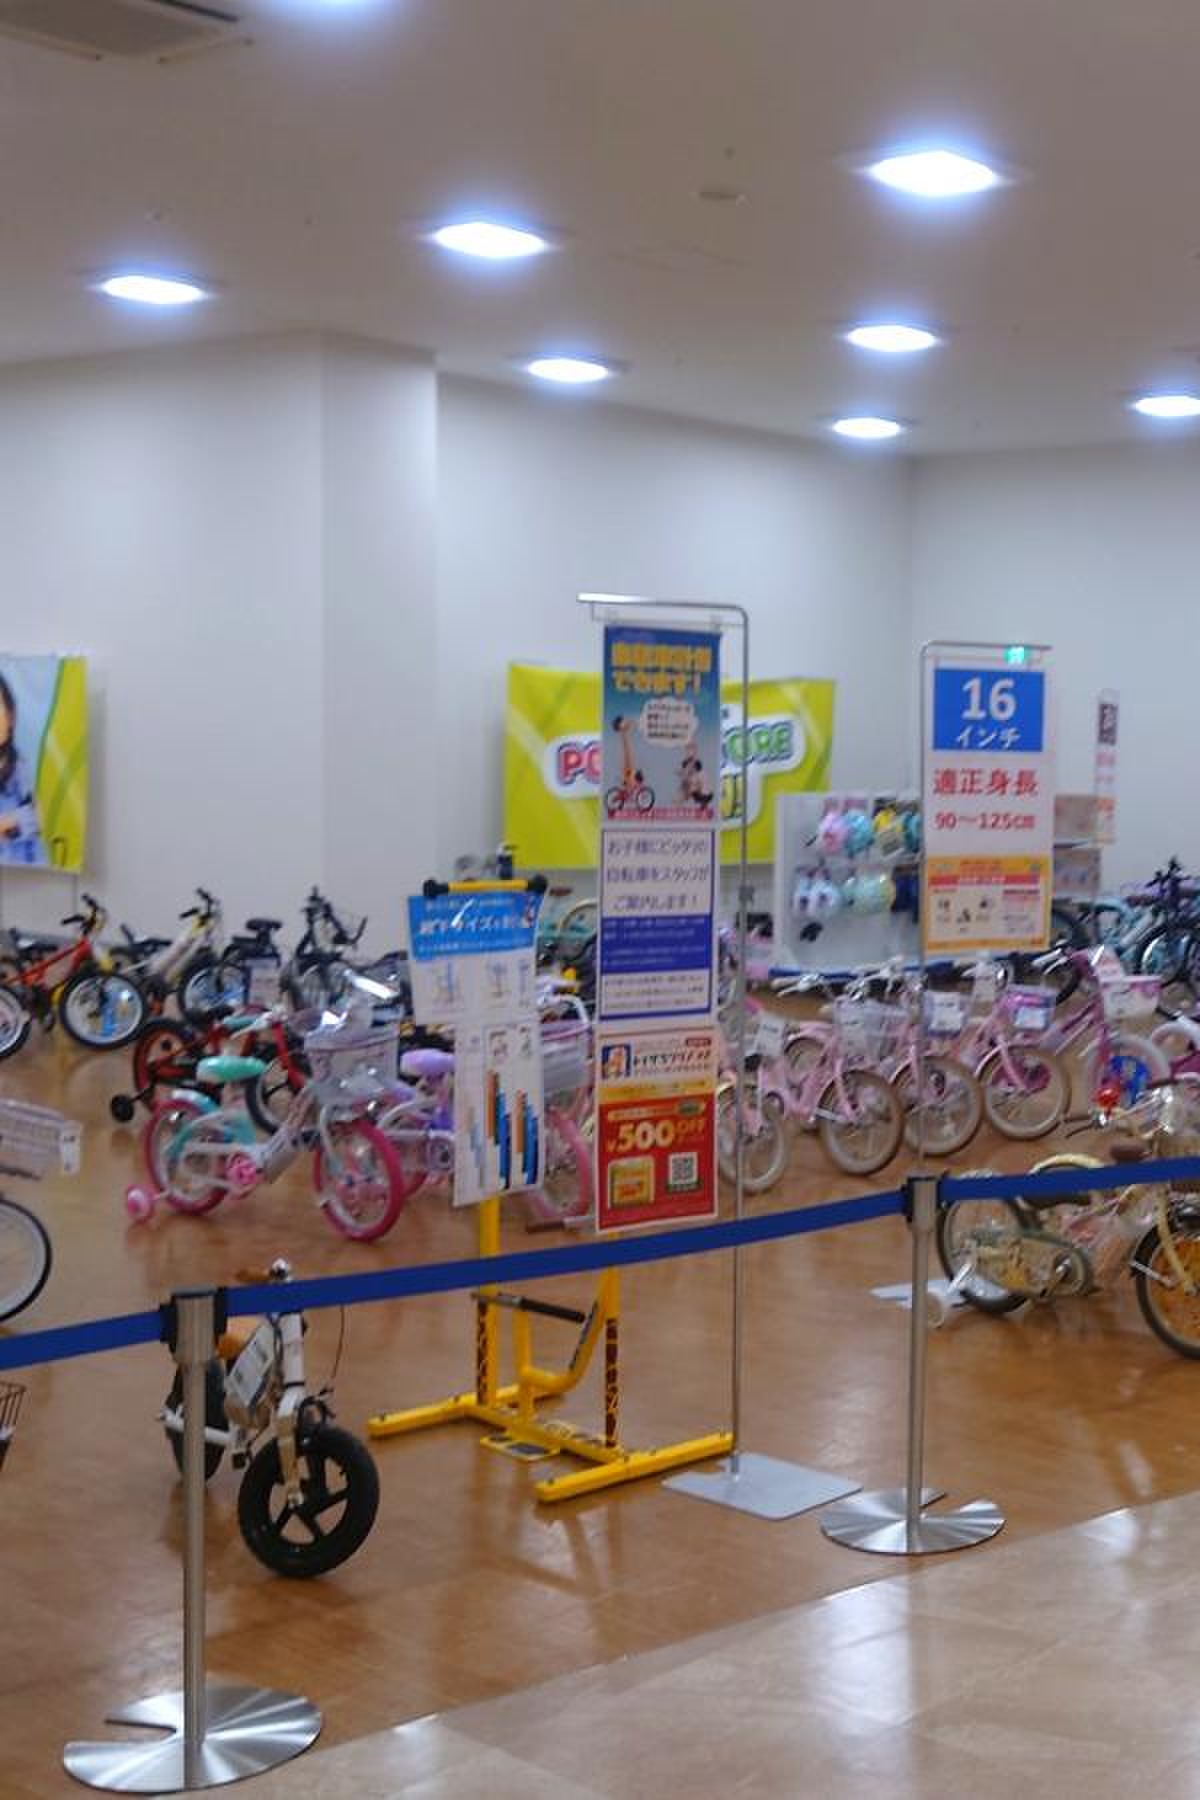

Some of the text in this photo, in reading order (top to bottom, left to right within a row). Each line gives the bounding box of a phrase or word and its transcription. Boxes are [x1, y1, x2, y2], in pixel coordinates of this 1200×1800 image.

[960, 676, 1018, 721] 16
[722, 720, 794, 768] ORE
[955, 725, 1022, 749] インチ
[932, 767, 1040, 797] 適正身長
